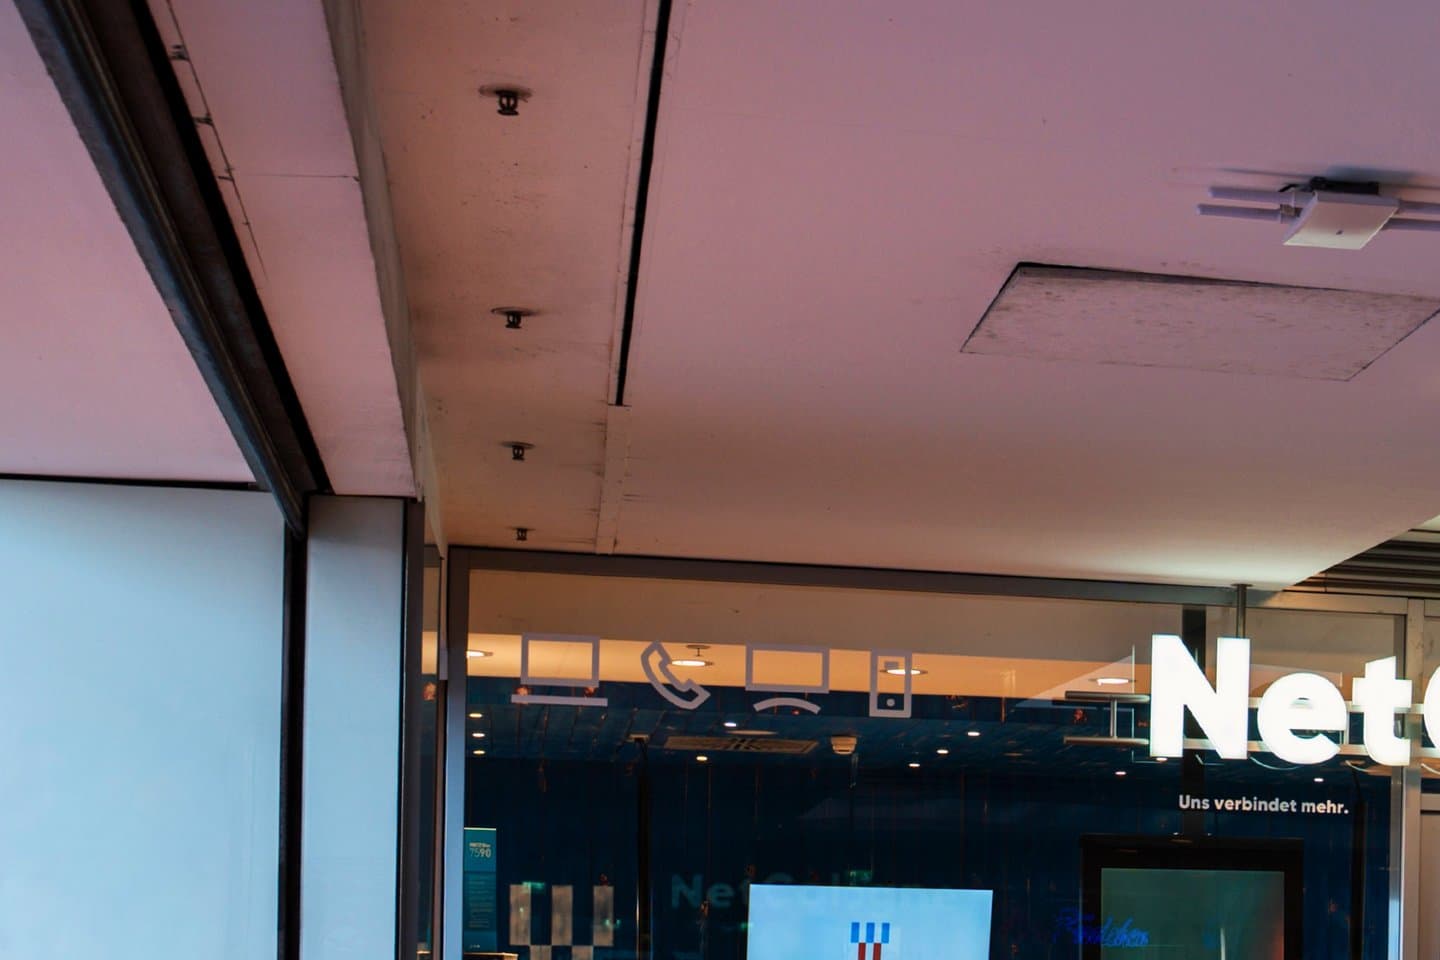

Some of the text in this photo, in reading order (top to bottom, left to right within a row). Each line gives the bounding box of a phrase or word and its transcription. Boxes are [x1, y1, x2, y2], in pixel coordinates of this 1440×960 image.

[1178, 794, 1349, 814] Uns verbindet mehr.
